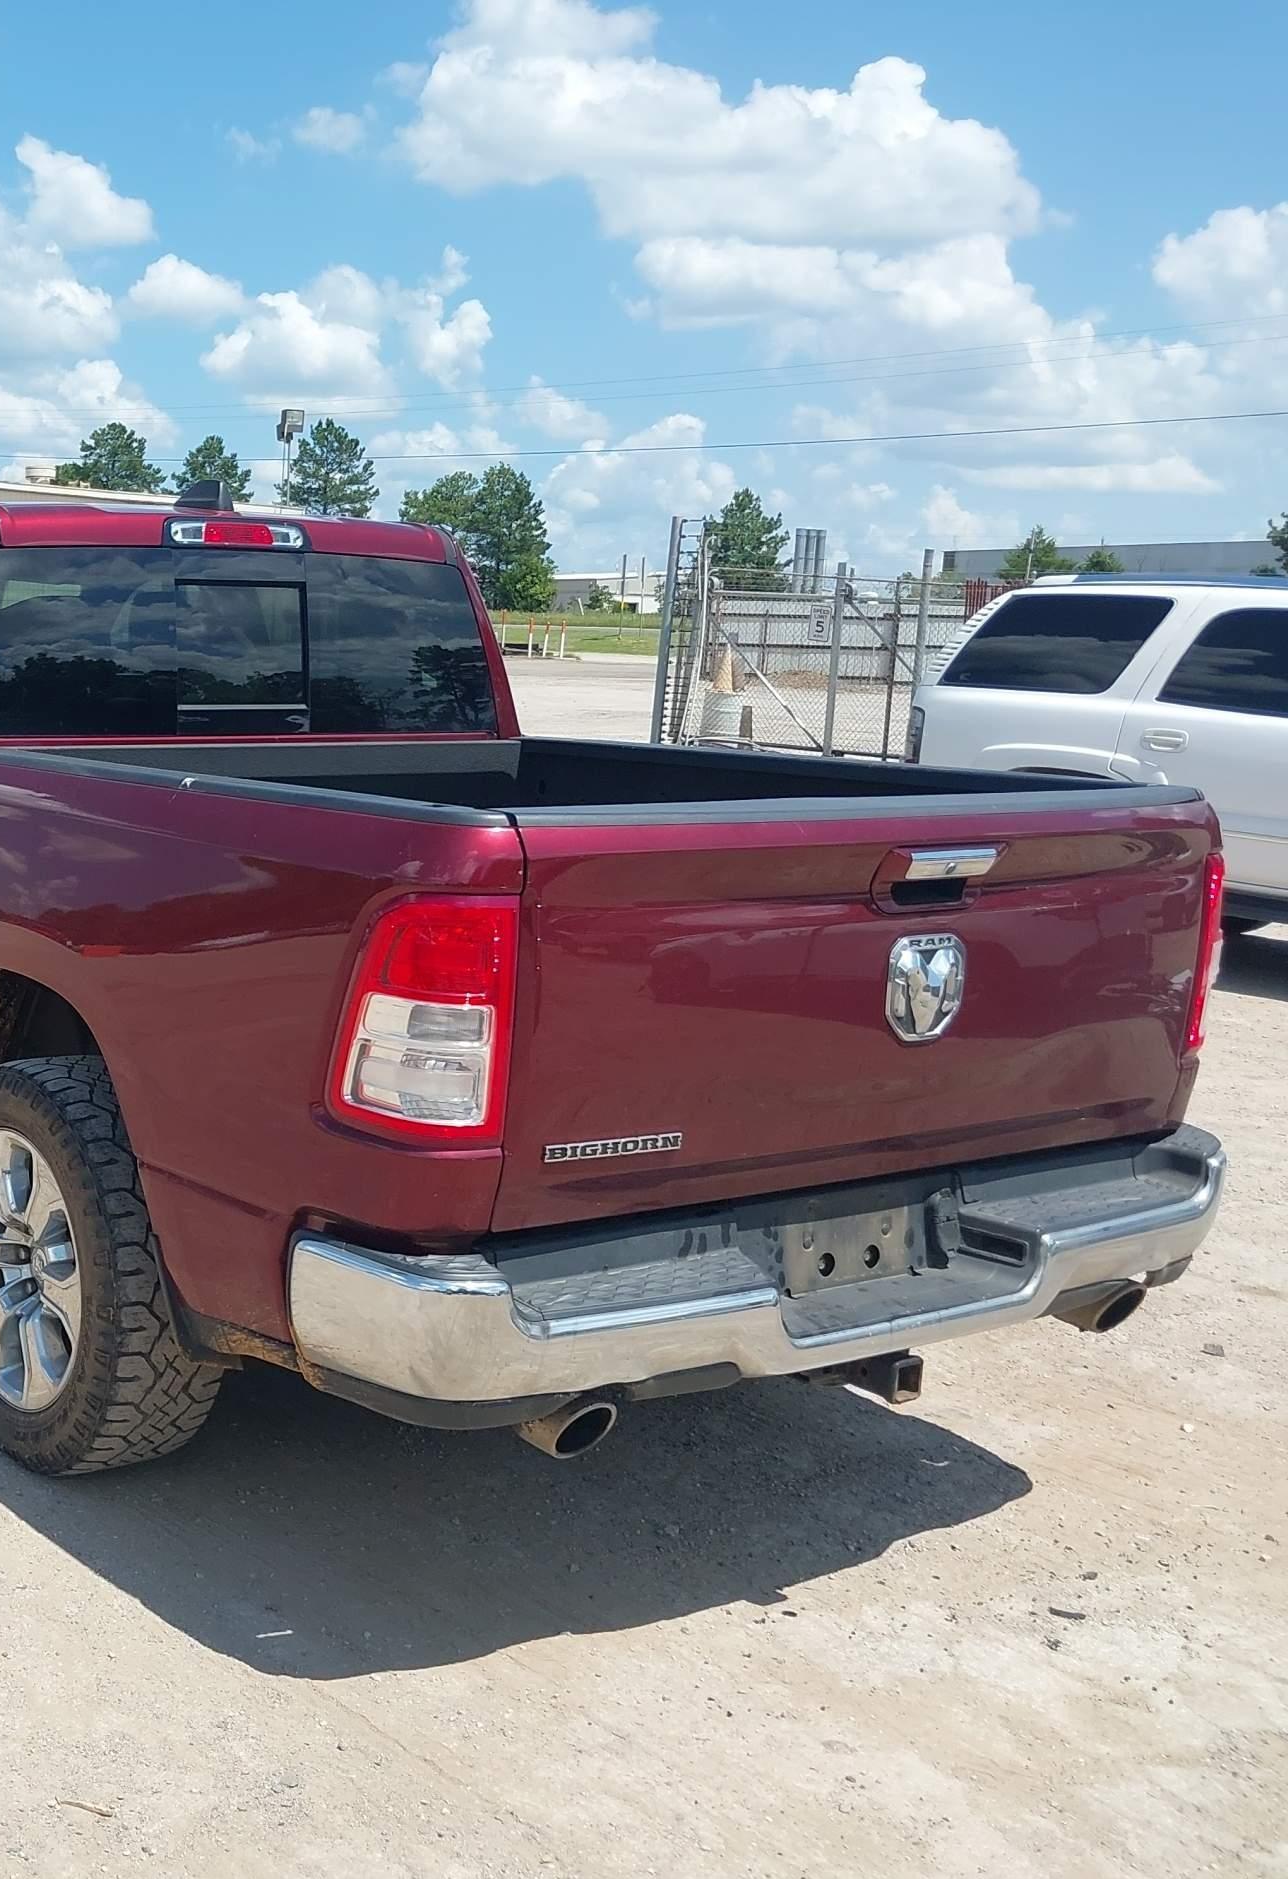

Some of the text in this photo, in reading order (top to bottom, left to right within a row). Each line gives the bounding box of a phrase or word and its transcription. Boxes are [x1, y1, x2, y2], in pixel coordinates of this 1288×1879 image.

[815, 620, 825, 634] 5
[909, 936, 953, 948] RAM
[544, 1132, 682, 1163] BIGHORN
